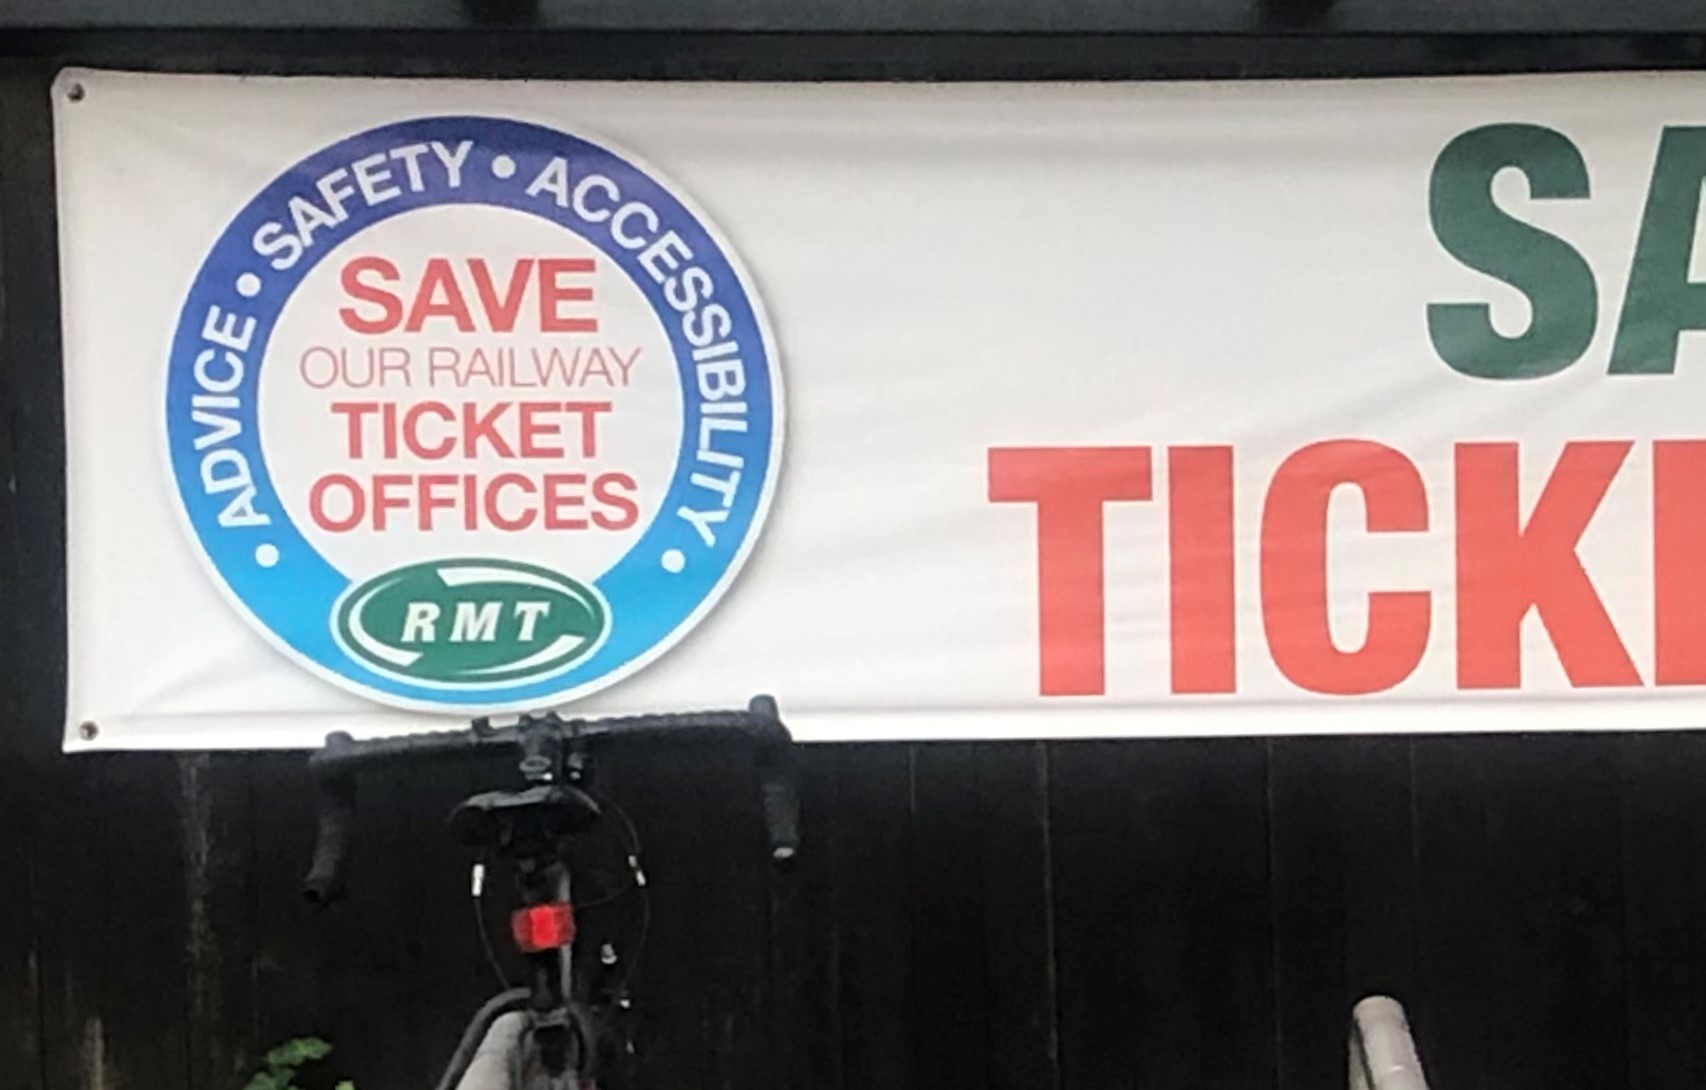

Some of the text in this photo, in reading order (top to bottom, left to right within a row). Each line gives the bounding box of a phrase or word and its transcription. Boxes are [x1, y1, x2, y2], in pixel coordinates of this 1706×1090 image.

[339, 255, 599, 335] SAVE
[192, 140, 748, 547] ADVICE SAFETY ACCESSIBILITY
[299, 345, 643, 390] OUR RAILWAY
[330, 400, 613, 460] TICKET
[308, 472, 640, 533] OFFICES
[400, 601, 551, 643] RMT
